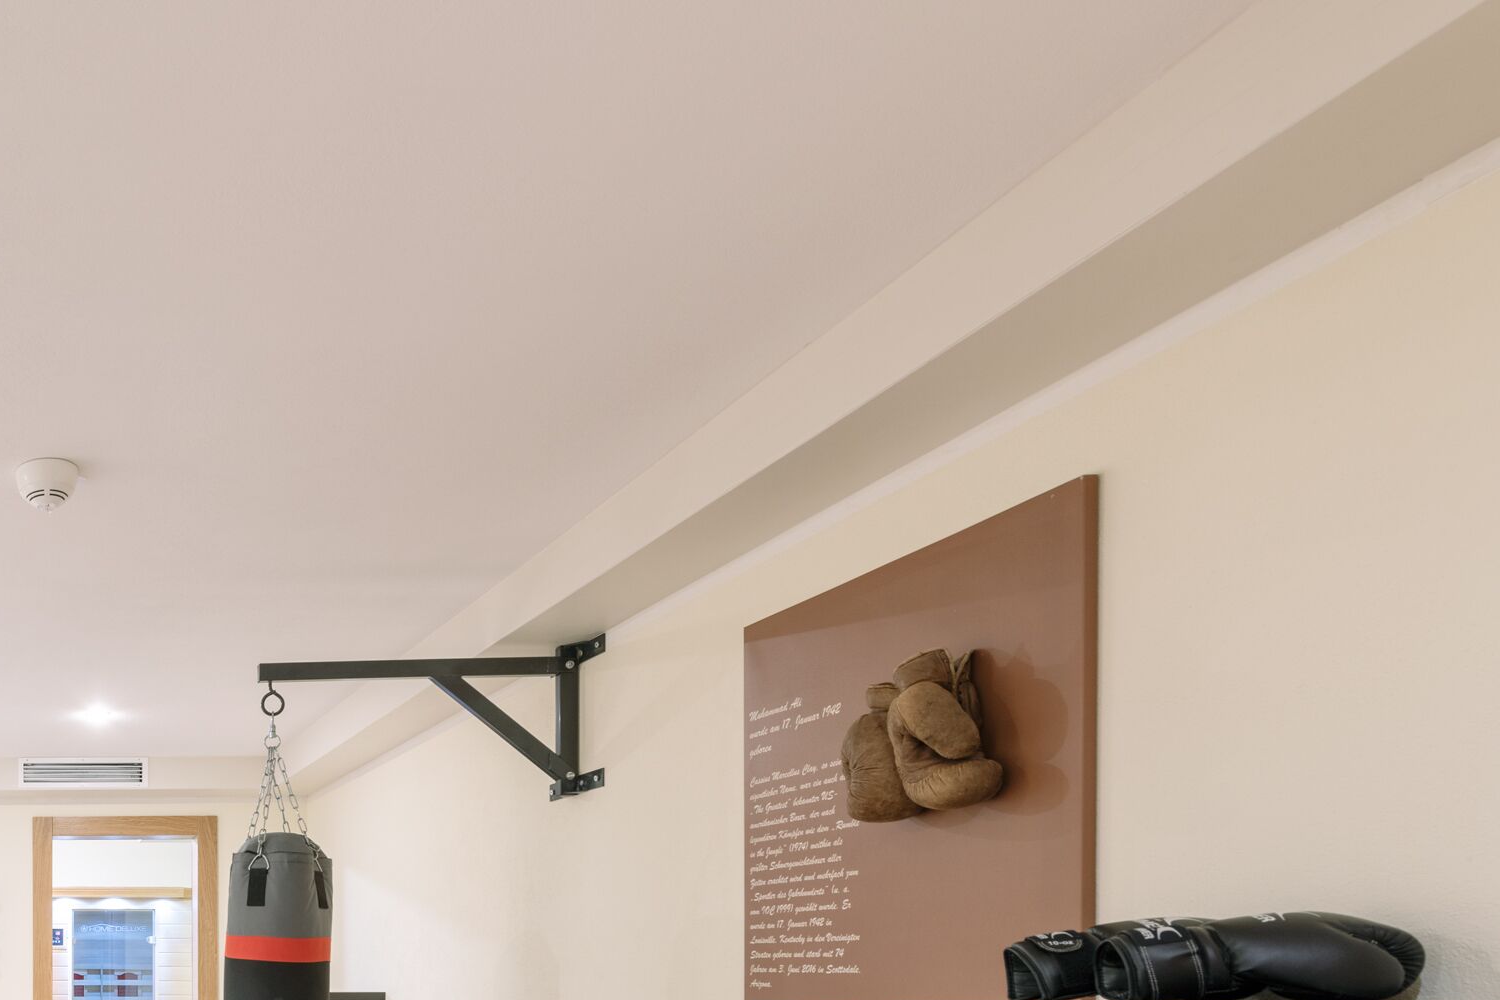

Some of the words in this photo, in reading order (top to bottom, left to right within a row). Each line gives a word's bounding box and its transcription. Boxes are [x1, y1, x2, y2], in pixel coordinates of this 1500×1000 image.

[789, 697, 802, 710] Ali
[769, 725, 780, 734] am
[794, 713, 820, 730] Januar
[822, 702, 842, 718] 1942
[809, 810, 819, 819] der
[788, 841, 809, 853] (1974)
[832, 836, 843, 846] als
[827, 853, 842, 863] aller
[776, 891, 787, 899] des
[776, 904, 794, 914] 1999)
[842, 899, 852, 910] Er
[787, 919, 808, 932] Januar
[809, 917, 825, 928] 1942
[779, 934, 806, 945] Kentucky
[826, 932, 861, 945] Vereinigten
[750, 950, 771, 959] Staaten
[772, 949, 793, 961] geboren
[793, 950, 805, 958] und
[806, 948, 822, 958] starb
[822, 950, 833, 958] mit
[834, 948, 845, 958] 74
[787, 964, 800, 976] Juni
[801, 964, 817, 974] 2016
